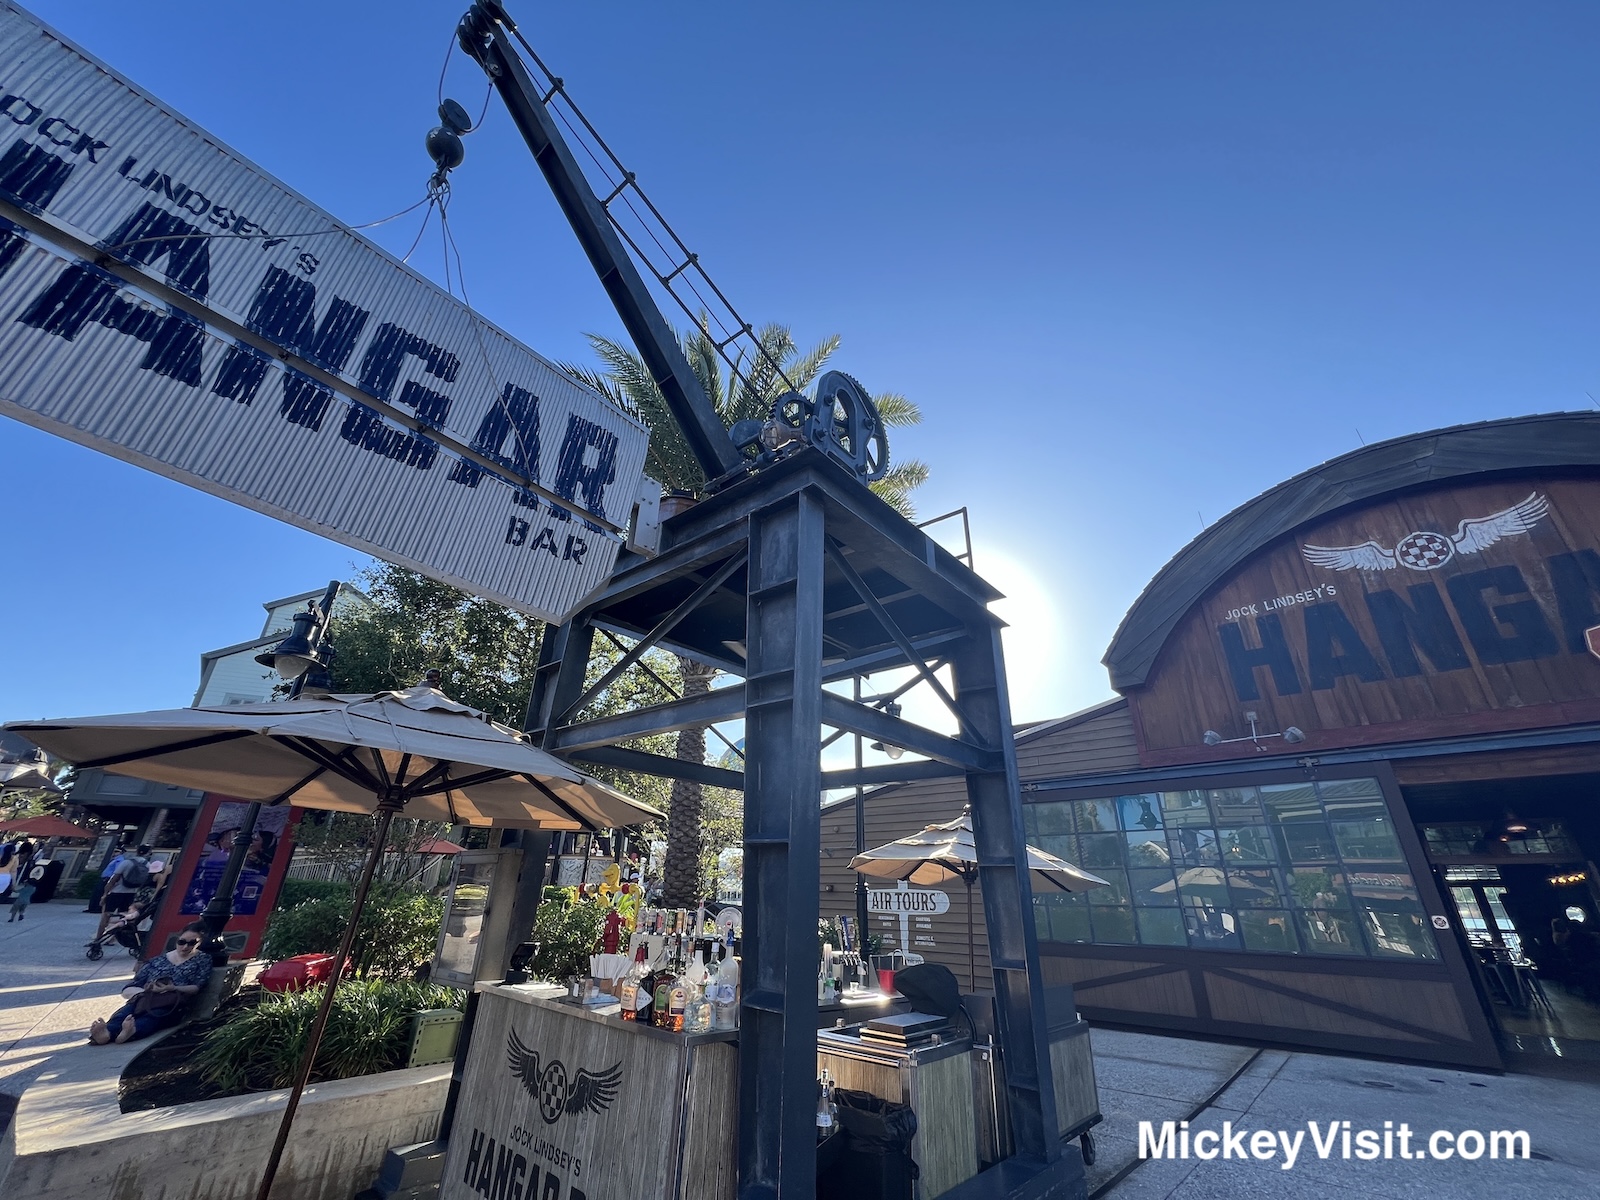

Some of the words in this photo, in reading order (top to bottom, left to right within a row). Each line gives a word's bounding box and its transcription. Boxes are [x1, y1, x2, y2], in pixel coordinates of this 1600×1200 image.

[0, 86, 109, 163] OCK
[118, 155, 320, 276] LINDSEY'S
[505, 515, 588, 565] BAR
[1225, 603, 1258, 620] JOCK
[1264, 583, 1337, 612] LINDSEY'S
[510, 1125, 534, 1149] JOCK
[533, 1133, 582, 1177] LINDSEY'S
